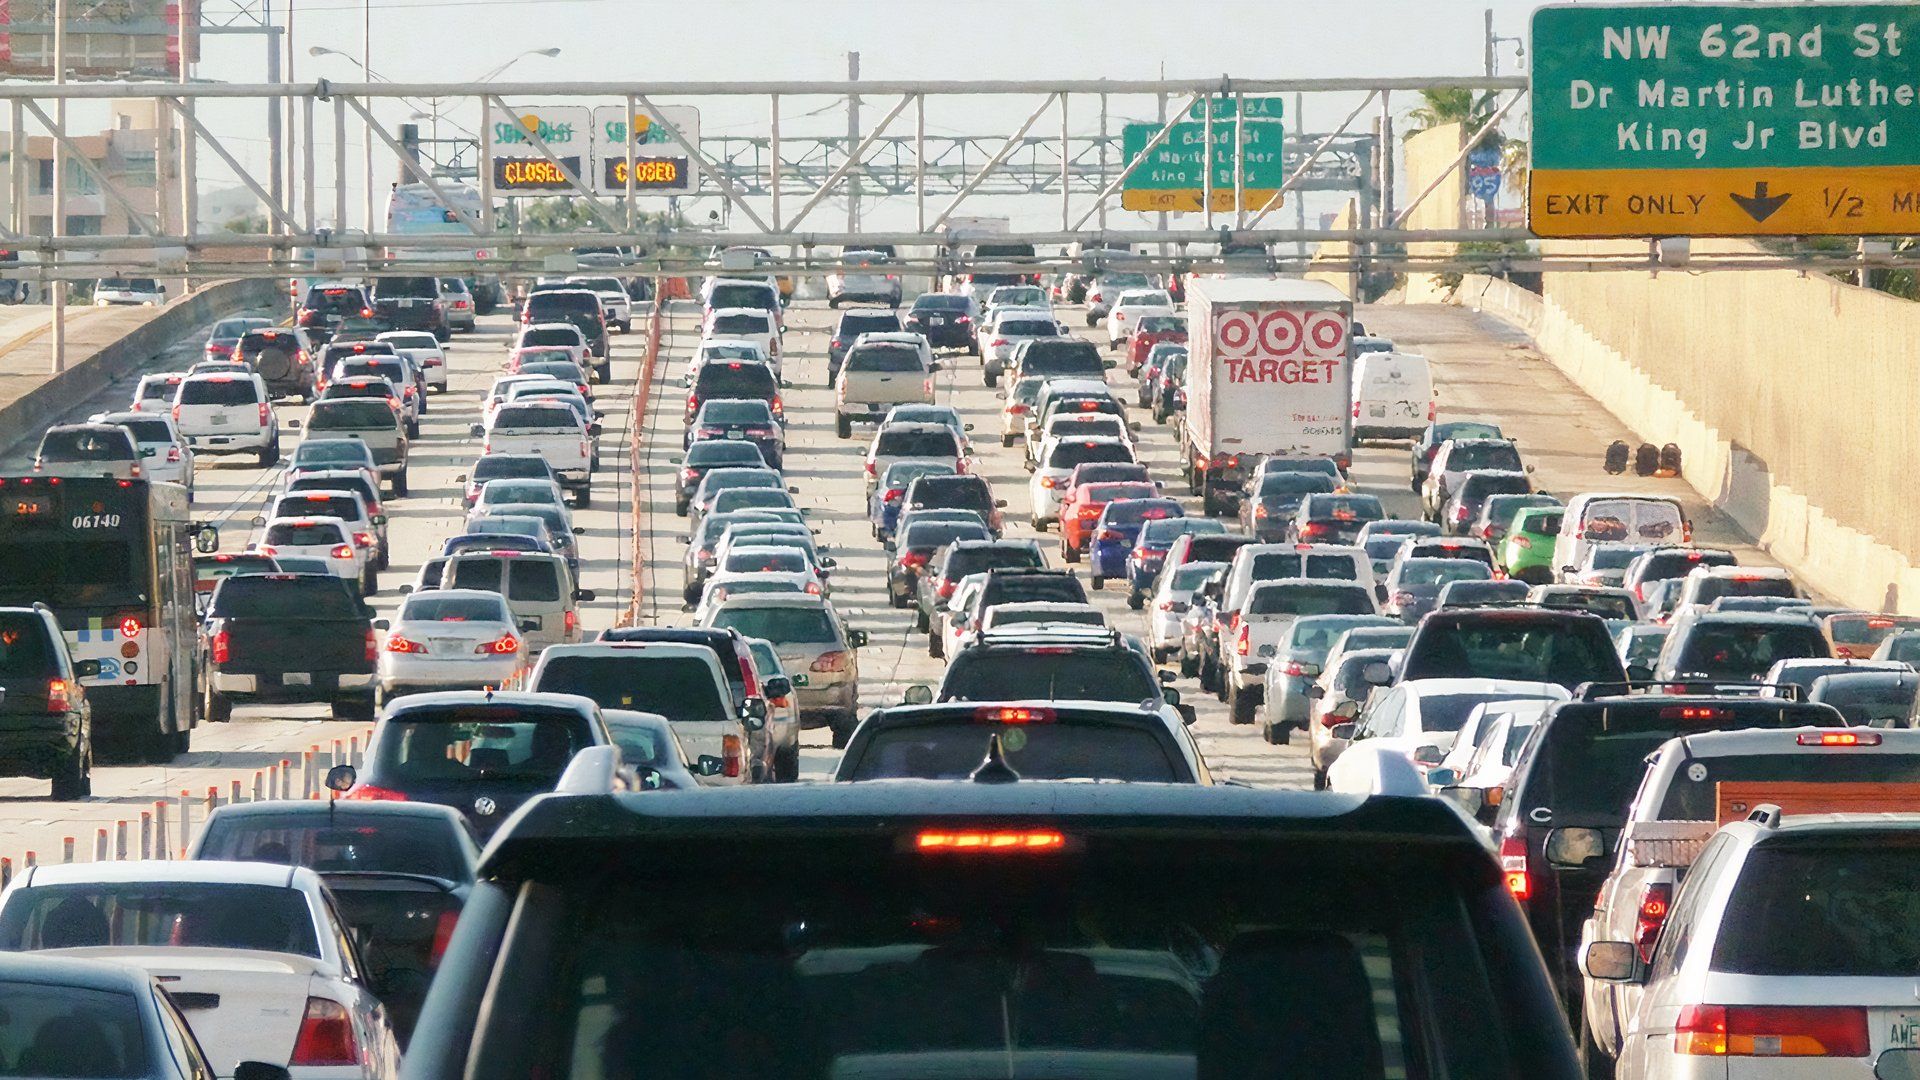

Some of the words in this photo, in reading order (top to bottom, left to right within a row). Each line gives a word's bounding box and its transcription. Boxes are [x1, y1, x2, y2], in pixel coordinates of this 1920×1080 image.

[1603, 25, 1670, 60] NW
[1700, 23, 1822, 59] 62nd
[1853, 22, 1902, 58] St
[1570, 79, 1612, 109] Dr
[1638, 78, 1773, 109] Martin
[1794, 77, 1920, 107] Luthe
[1617, 120, 1707, 159] King
[1733, 120, 1775, 150] Jr
[1799, 119, 1887, 150] Blvd
[505, 162, 566, 183] CLOSED
[614, 162, 676, 182] COSED
[1546, 194, 1609, 215] EXIT
[1628, 194, 1706, 215] ONLY
[1224, 358, 1339, 384] TARGET
